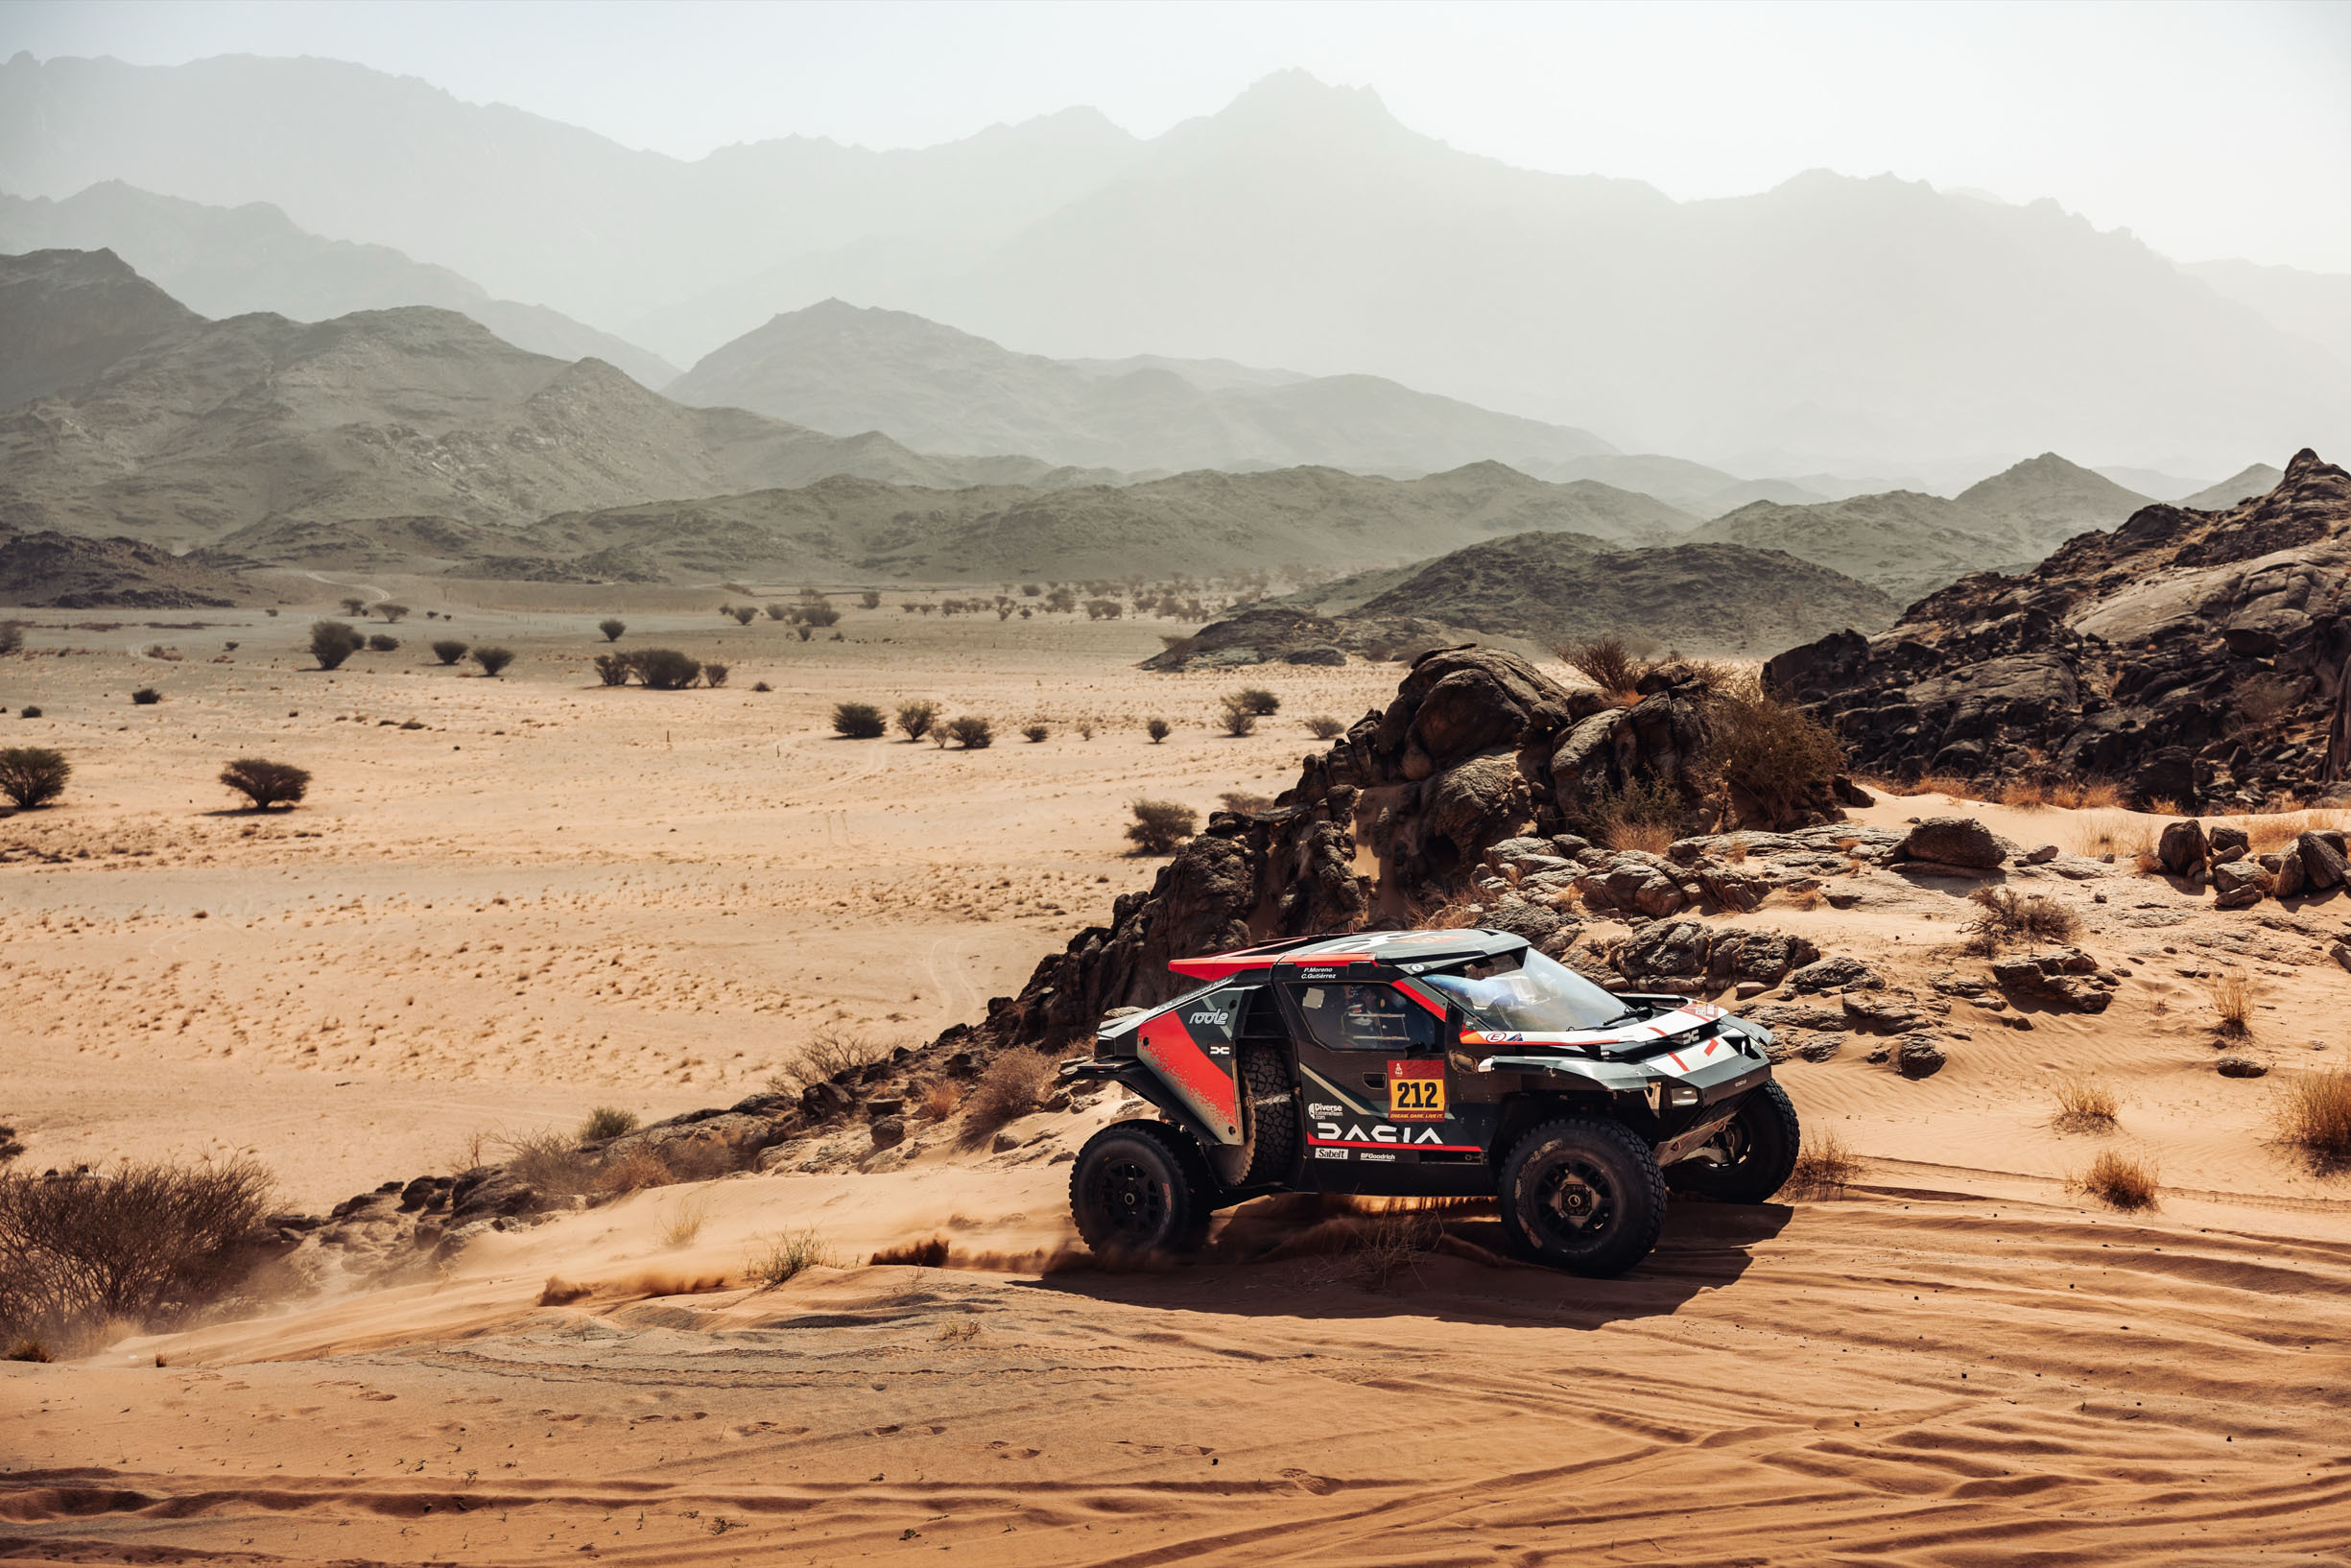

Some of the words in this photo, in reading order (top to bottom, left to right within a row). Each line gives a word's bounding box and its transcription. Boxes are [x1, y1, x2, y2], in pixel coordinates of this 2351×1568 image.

[1397, 1081, 1438, 1108] 212
[1315, 1103, 1342, 1111] Diverse
[1318, 1123, 1443, 1144] DACIA
[1318, 1149, 1344, 1159] Sabelt
[1361, 1152, 1395, 1160] BFGoodrich
